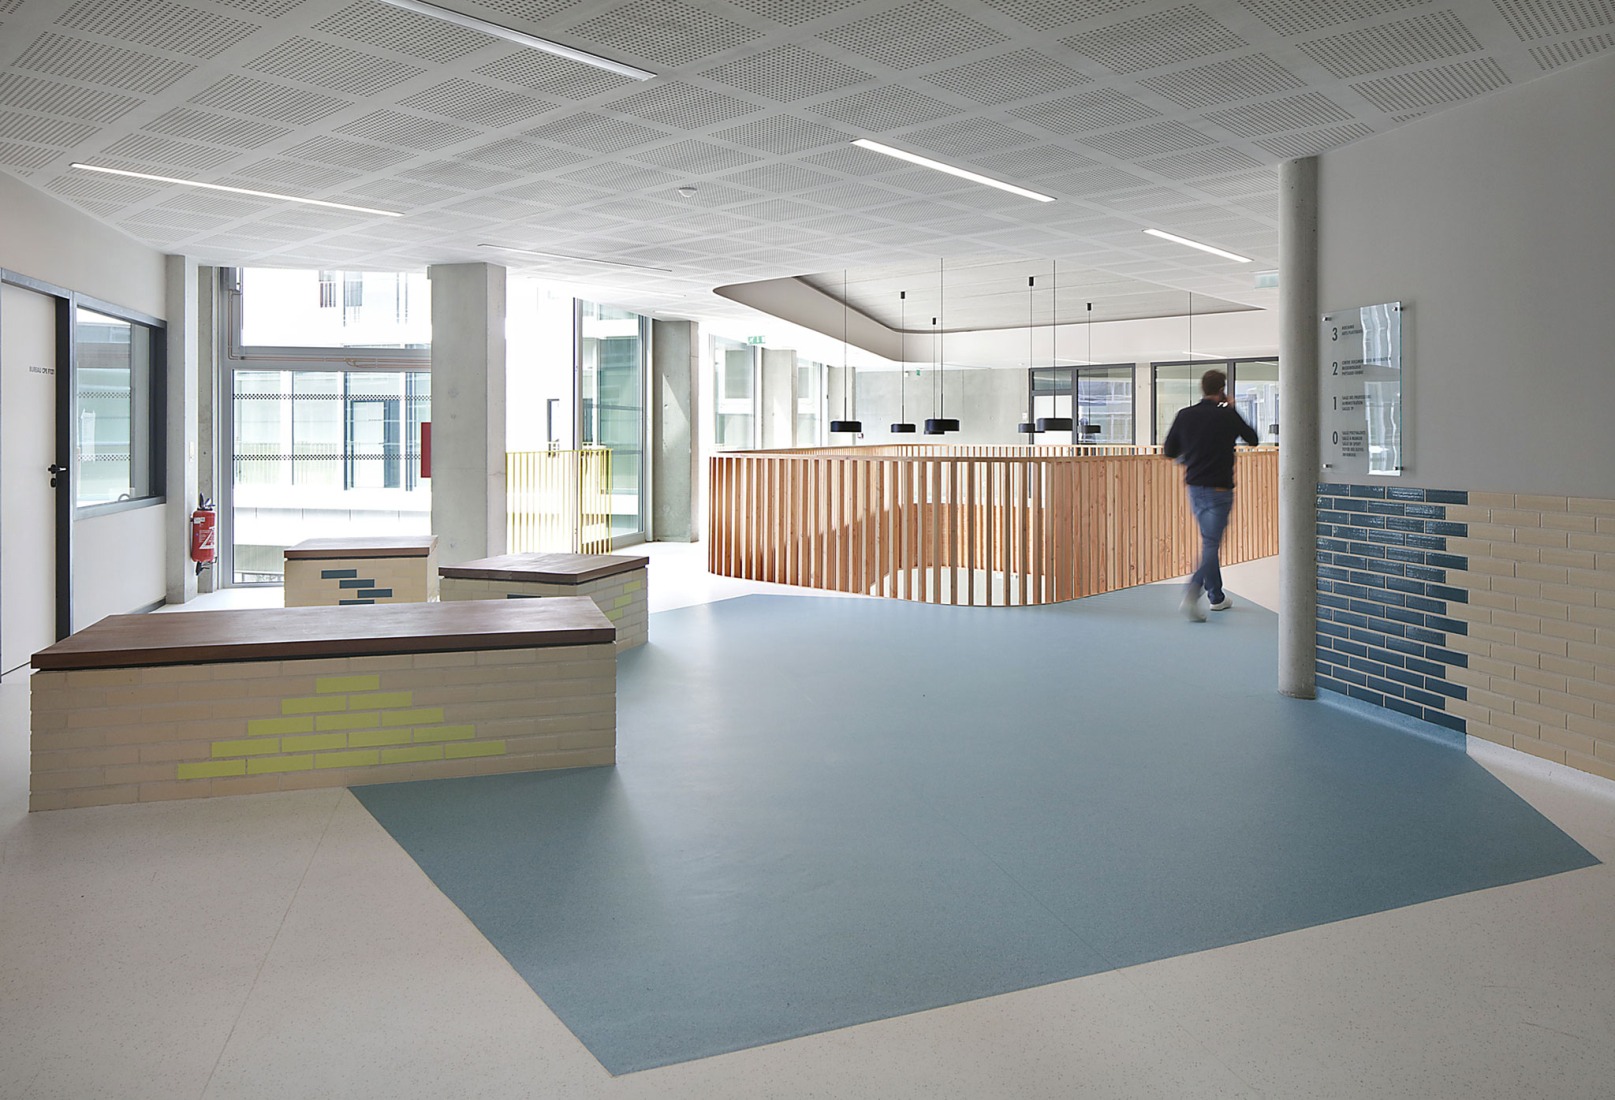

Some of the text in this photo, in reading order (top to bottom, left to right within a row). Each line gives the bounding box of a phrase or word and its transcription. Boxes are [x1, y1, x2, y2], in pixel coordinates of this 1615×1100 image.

[1332, 327, 1338, 341] 3
[1332, 361, 1338, 376] 2
[1333, 396, 1337, 410] 1
[1332, 431, 1338, 445] 0
